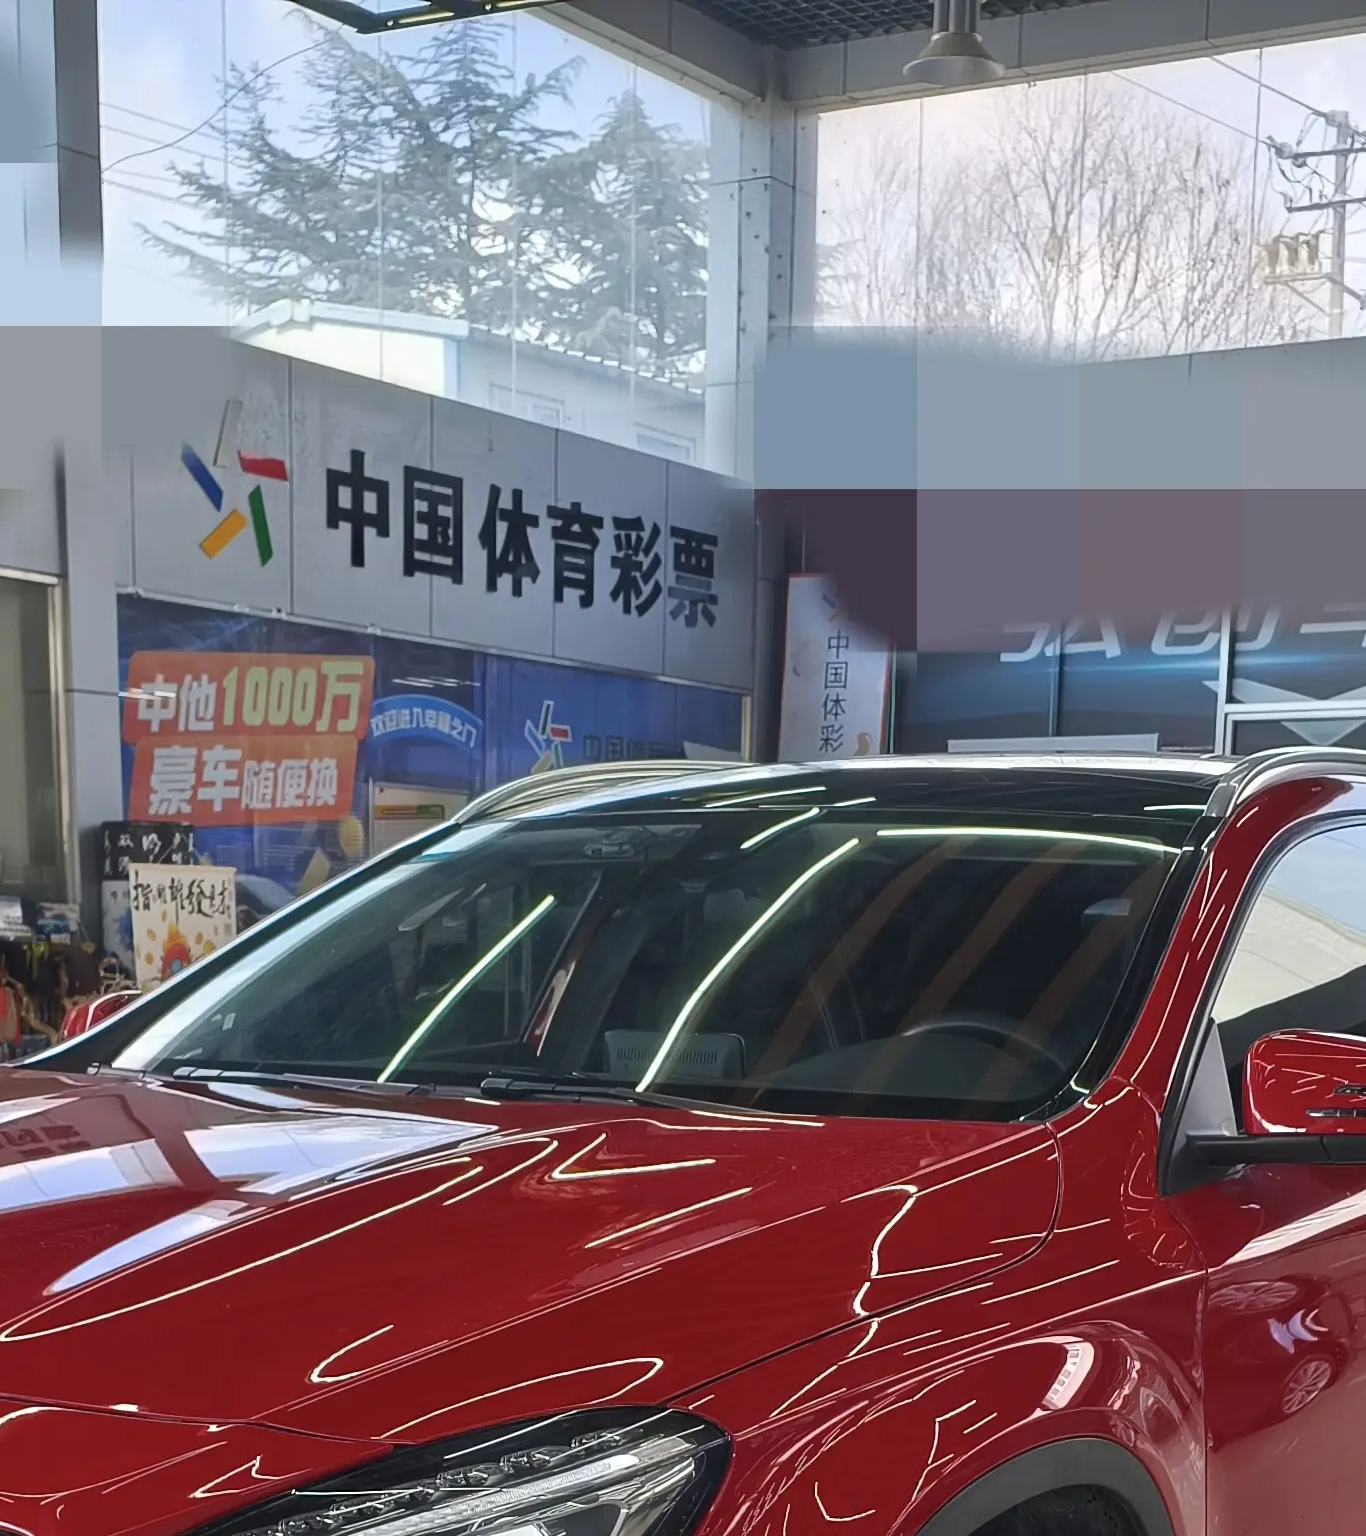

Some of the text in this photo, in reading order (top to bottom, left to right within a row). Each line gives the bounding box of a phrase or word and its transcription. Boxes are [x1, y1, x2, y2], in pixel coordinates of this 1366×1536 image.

[326, 449, 718, 628] 中国体育彩票
[138, 661, 364, 732] 中他1000万
[819, 629, 849, 752] 中国体彩
[149, 744, 338, 815] 豪车随便换
